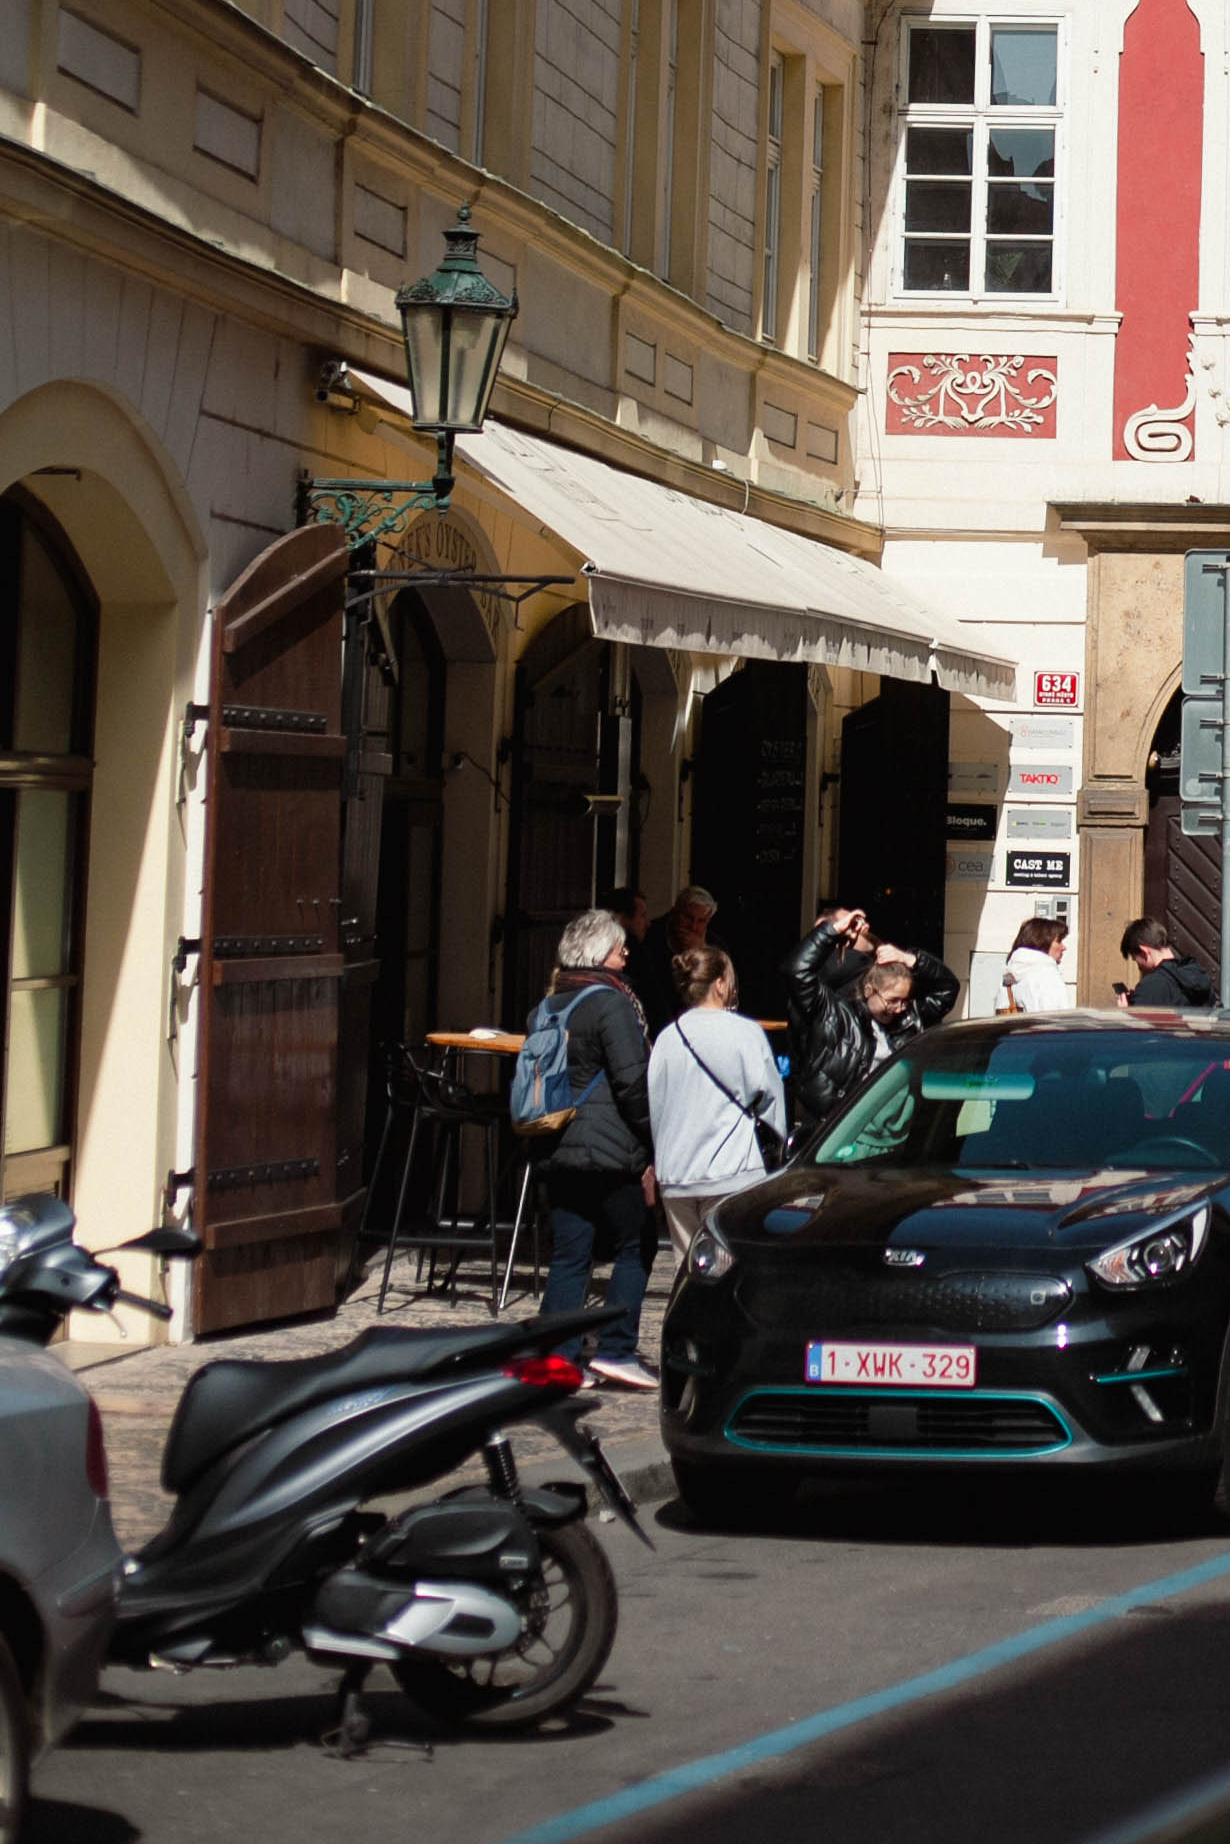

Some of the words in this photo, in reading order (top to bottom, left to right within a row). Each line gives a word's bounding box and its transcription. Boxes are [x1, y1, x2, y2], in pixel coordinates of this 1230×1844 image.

[1042, 675, 1072, 692] 634
[1020, 773, 1058, 785] TAKTIQ
[958, 860, 984, 872] cea
[1013, 859, 1042, 870] CAST
[1046, 860, 1063, 871] ME
[886, 1250, 918, 1263] KIA
